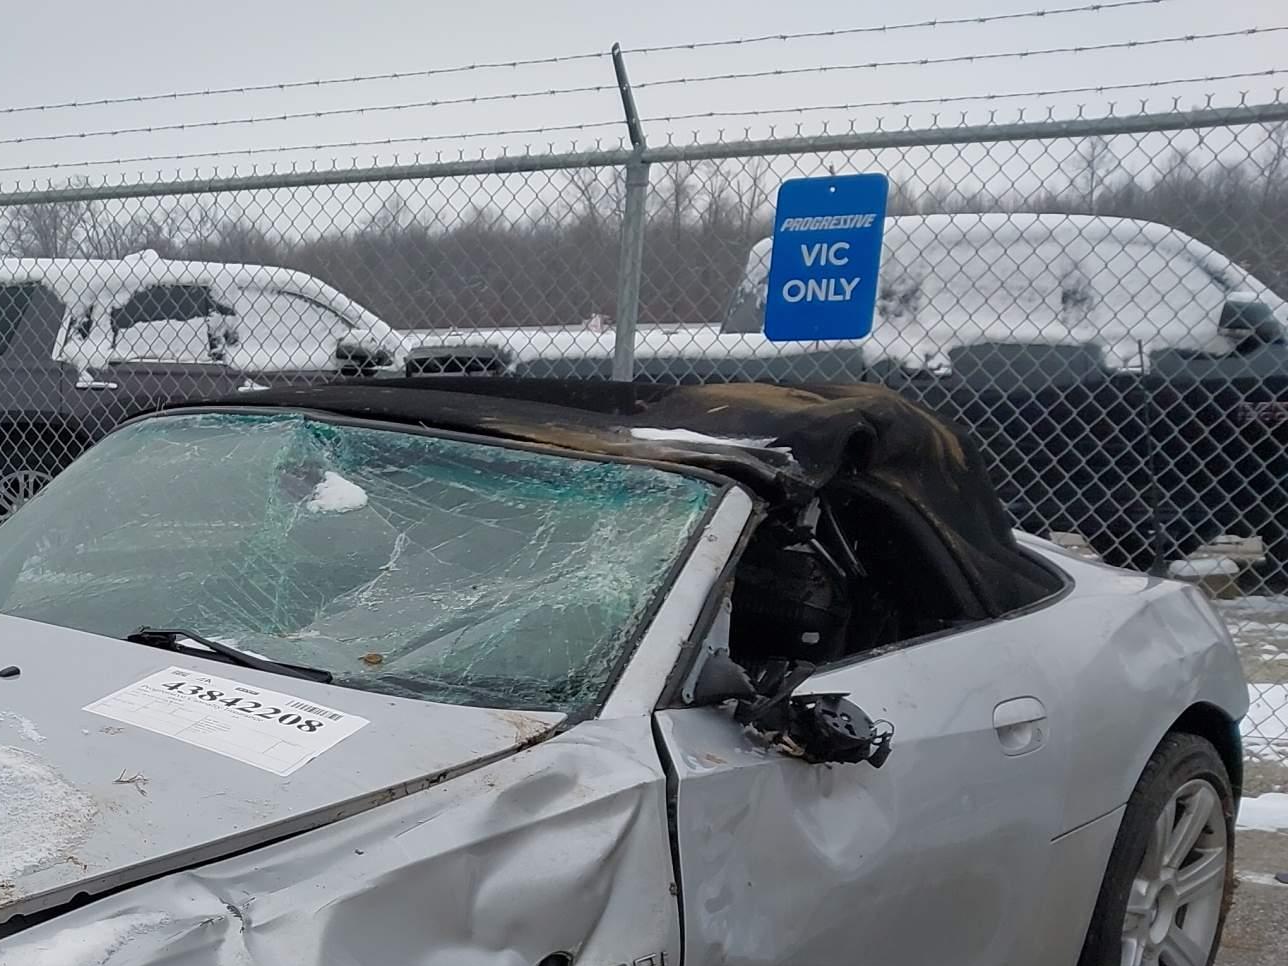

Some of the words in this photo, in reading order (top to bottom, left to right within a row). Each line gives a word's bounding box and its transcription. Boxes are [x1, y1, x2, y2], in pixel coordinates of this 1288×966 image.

[780, 213, 877, 232] PROGRESSIVE
[800, 241, 850, 267] VIC
[782, 277, 861, 303] ONLY
[161, 681, 324, 733] 43842208
